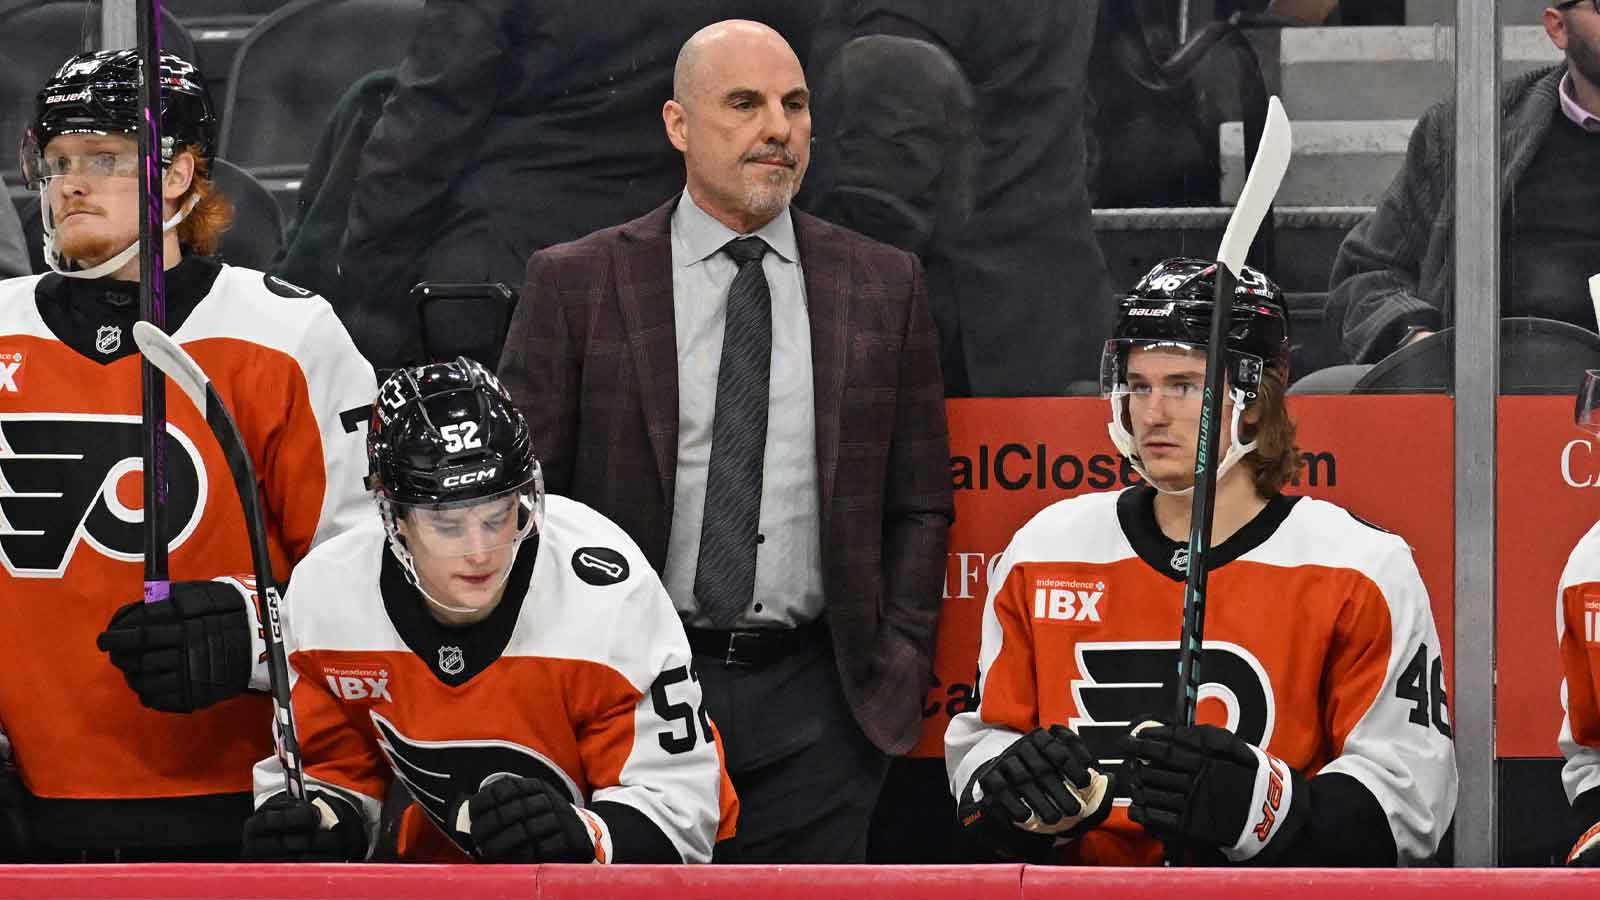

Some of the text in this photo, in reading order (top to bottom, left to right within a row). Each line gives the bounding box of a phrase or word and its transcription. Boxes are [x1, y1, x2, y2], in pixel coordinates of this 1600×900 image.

[440, 420, 481, 452] 52
[443, 467, 497, 487] CCM
[267, 591, 281, 638] CCM
[1034, 588, 1104, 622] IBX
[325, 675, 392, 703] IBX
